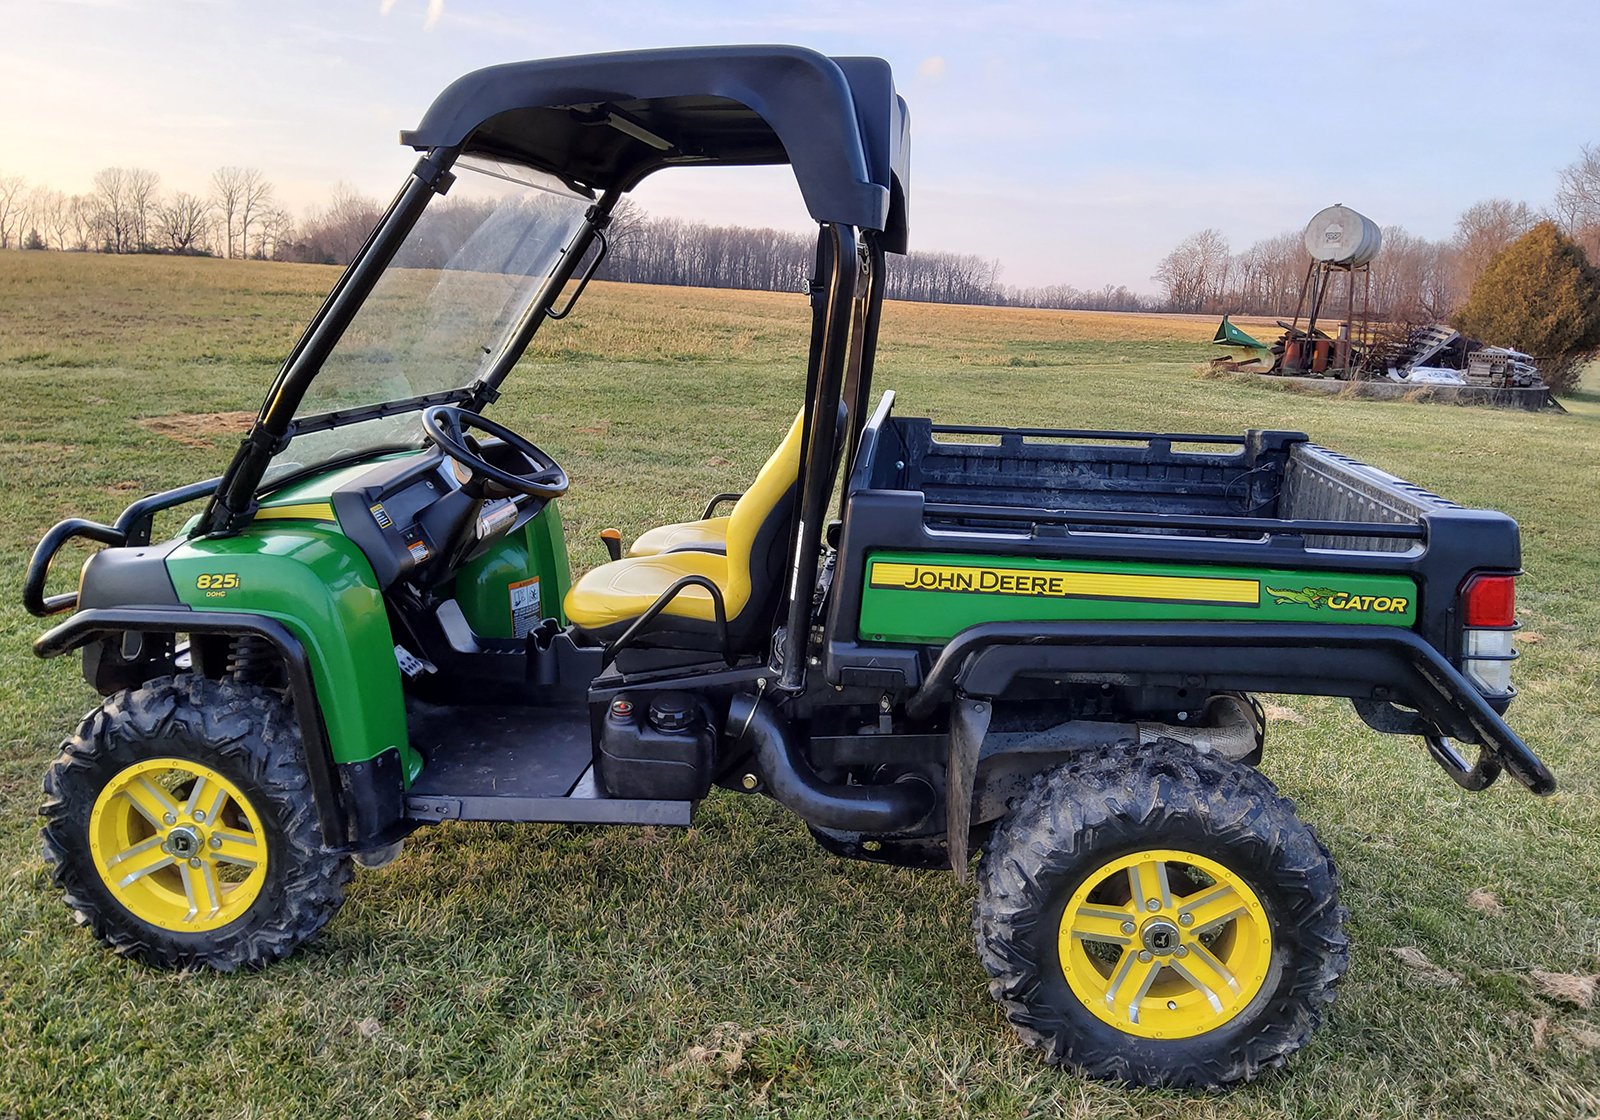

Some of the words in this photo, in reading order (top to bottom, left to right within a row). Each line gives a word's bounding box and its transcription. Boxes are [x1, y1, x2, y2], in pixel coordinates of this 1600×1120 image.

[196, 573, 240, 590] 825i
[904, 567, 973, 589] JOHN
[979, 570, 1064, 593] DEERE
[1327, 592, 1408, 613] GATOR
